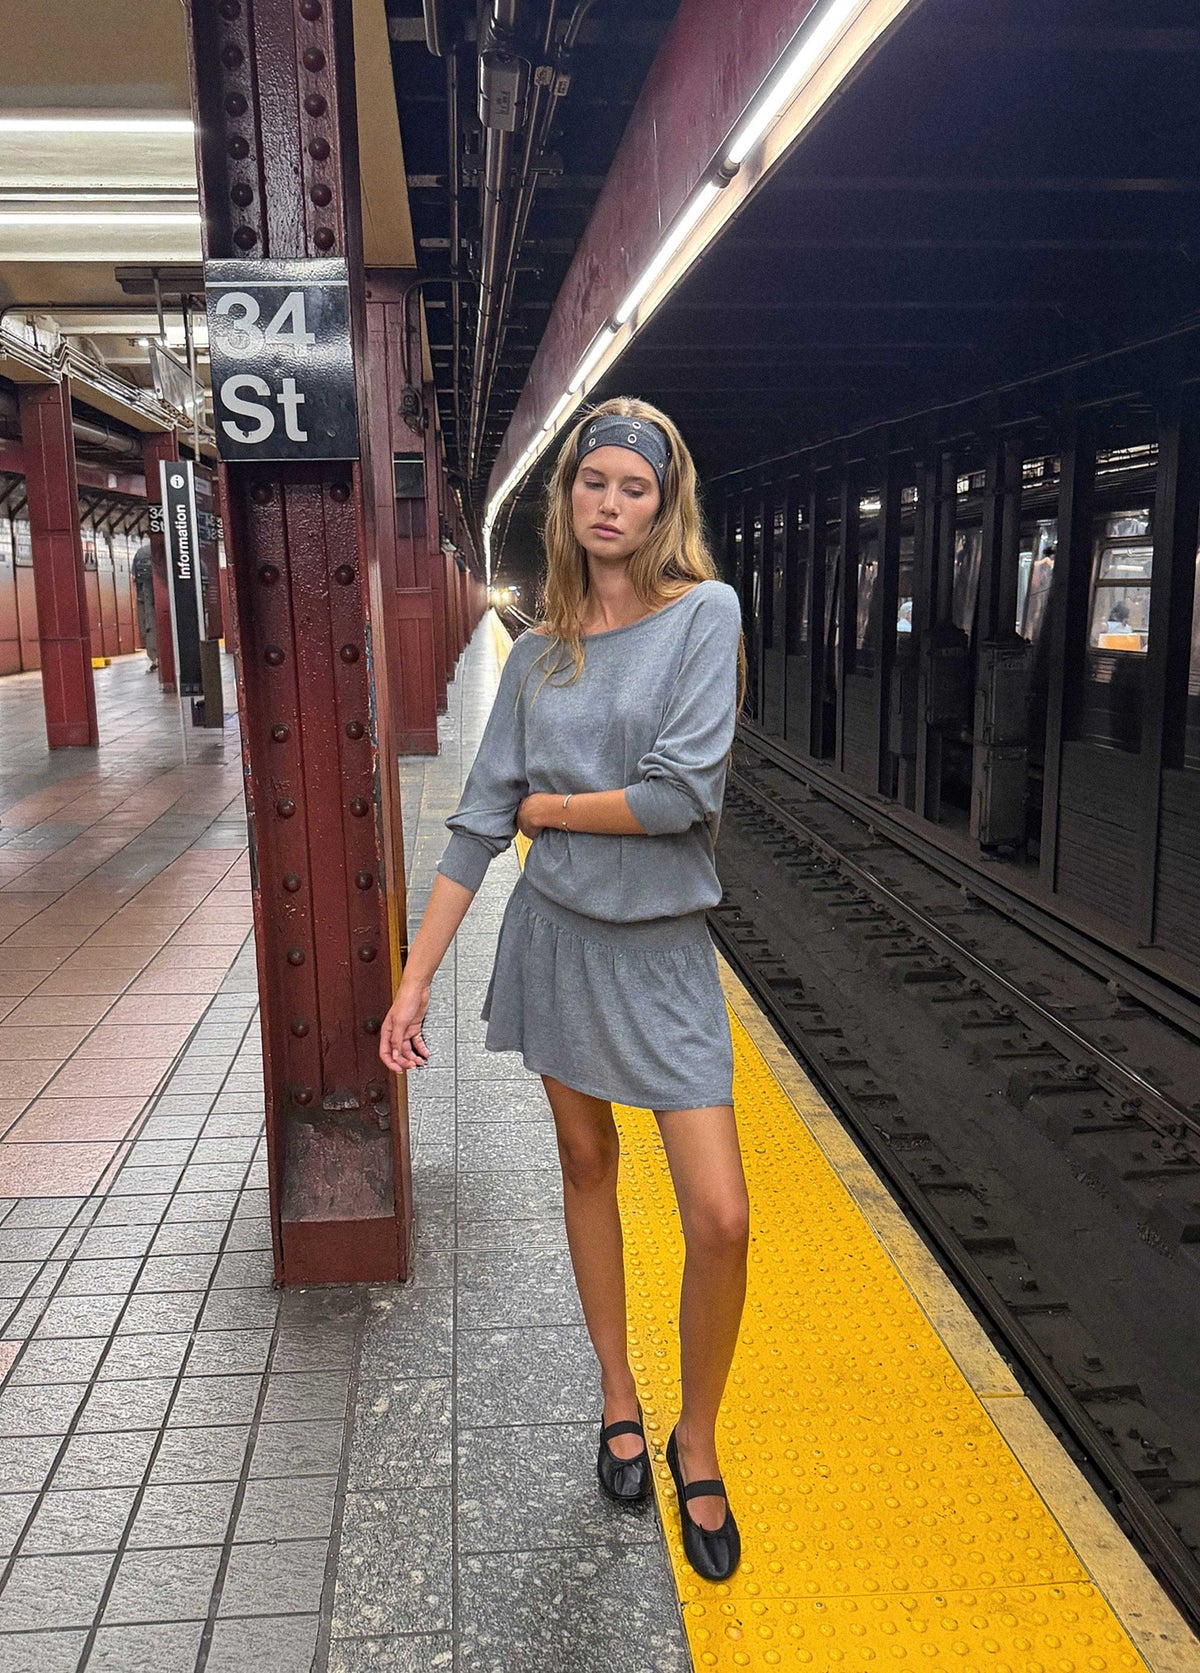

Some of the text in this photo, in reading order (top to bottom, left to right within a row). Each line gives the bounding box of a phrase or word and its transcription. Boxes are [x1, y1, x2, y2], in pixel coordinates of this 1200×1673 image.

[215, 291, 316, 360] 34
[220, 373, 308, 444] St
[174, 504, 191, 579] Information
